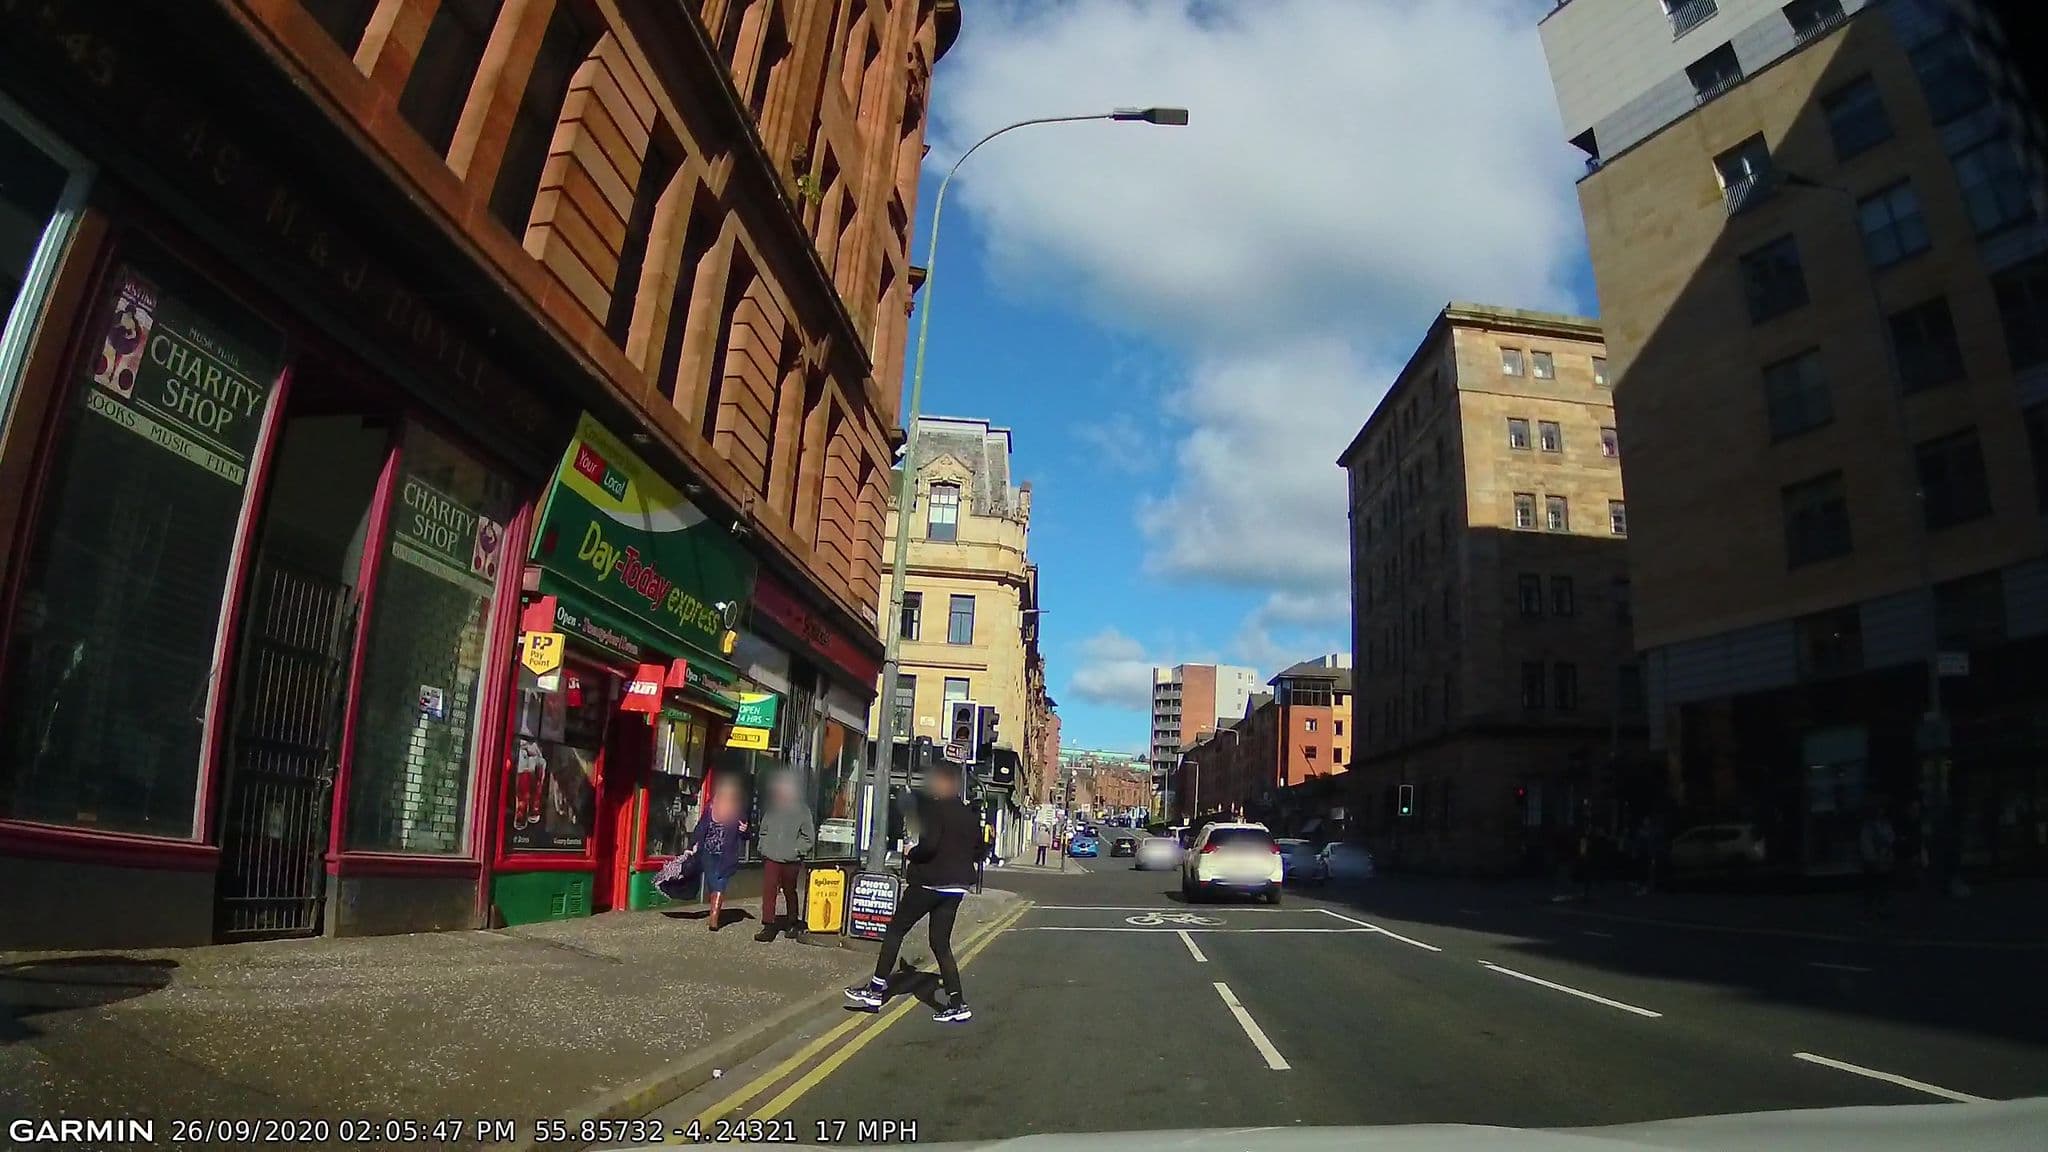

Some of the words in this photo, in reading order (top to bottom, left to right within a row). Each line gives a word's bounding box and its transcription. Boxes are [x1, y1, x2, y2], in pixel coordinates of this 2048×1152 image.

[150, 334, 262, 418] CHARITY
[161, 378, 234, 434] SHOP
[150, 424, 192, 458] MUSIC
[206, 454, 240, 482] FILM
[579, 449, 600, 474] Your
[403, 482, 476, 537] CHARITY
[412, 513, 459, 553] SHOP
[556, 606, 577, 626] Open
[666, 586, 721, 637] express
[528, 655, 550, 668] Point
[529, 650, 545, 660] Pay
[855, 886, 894, 898] COPYING
[860, 880, 890, 890] PHOTO
